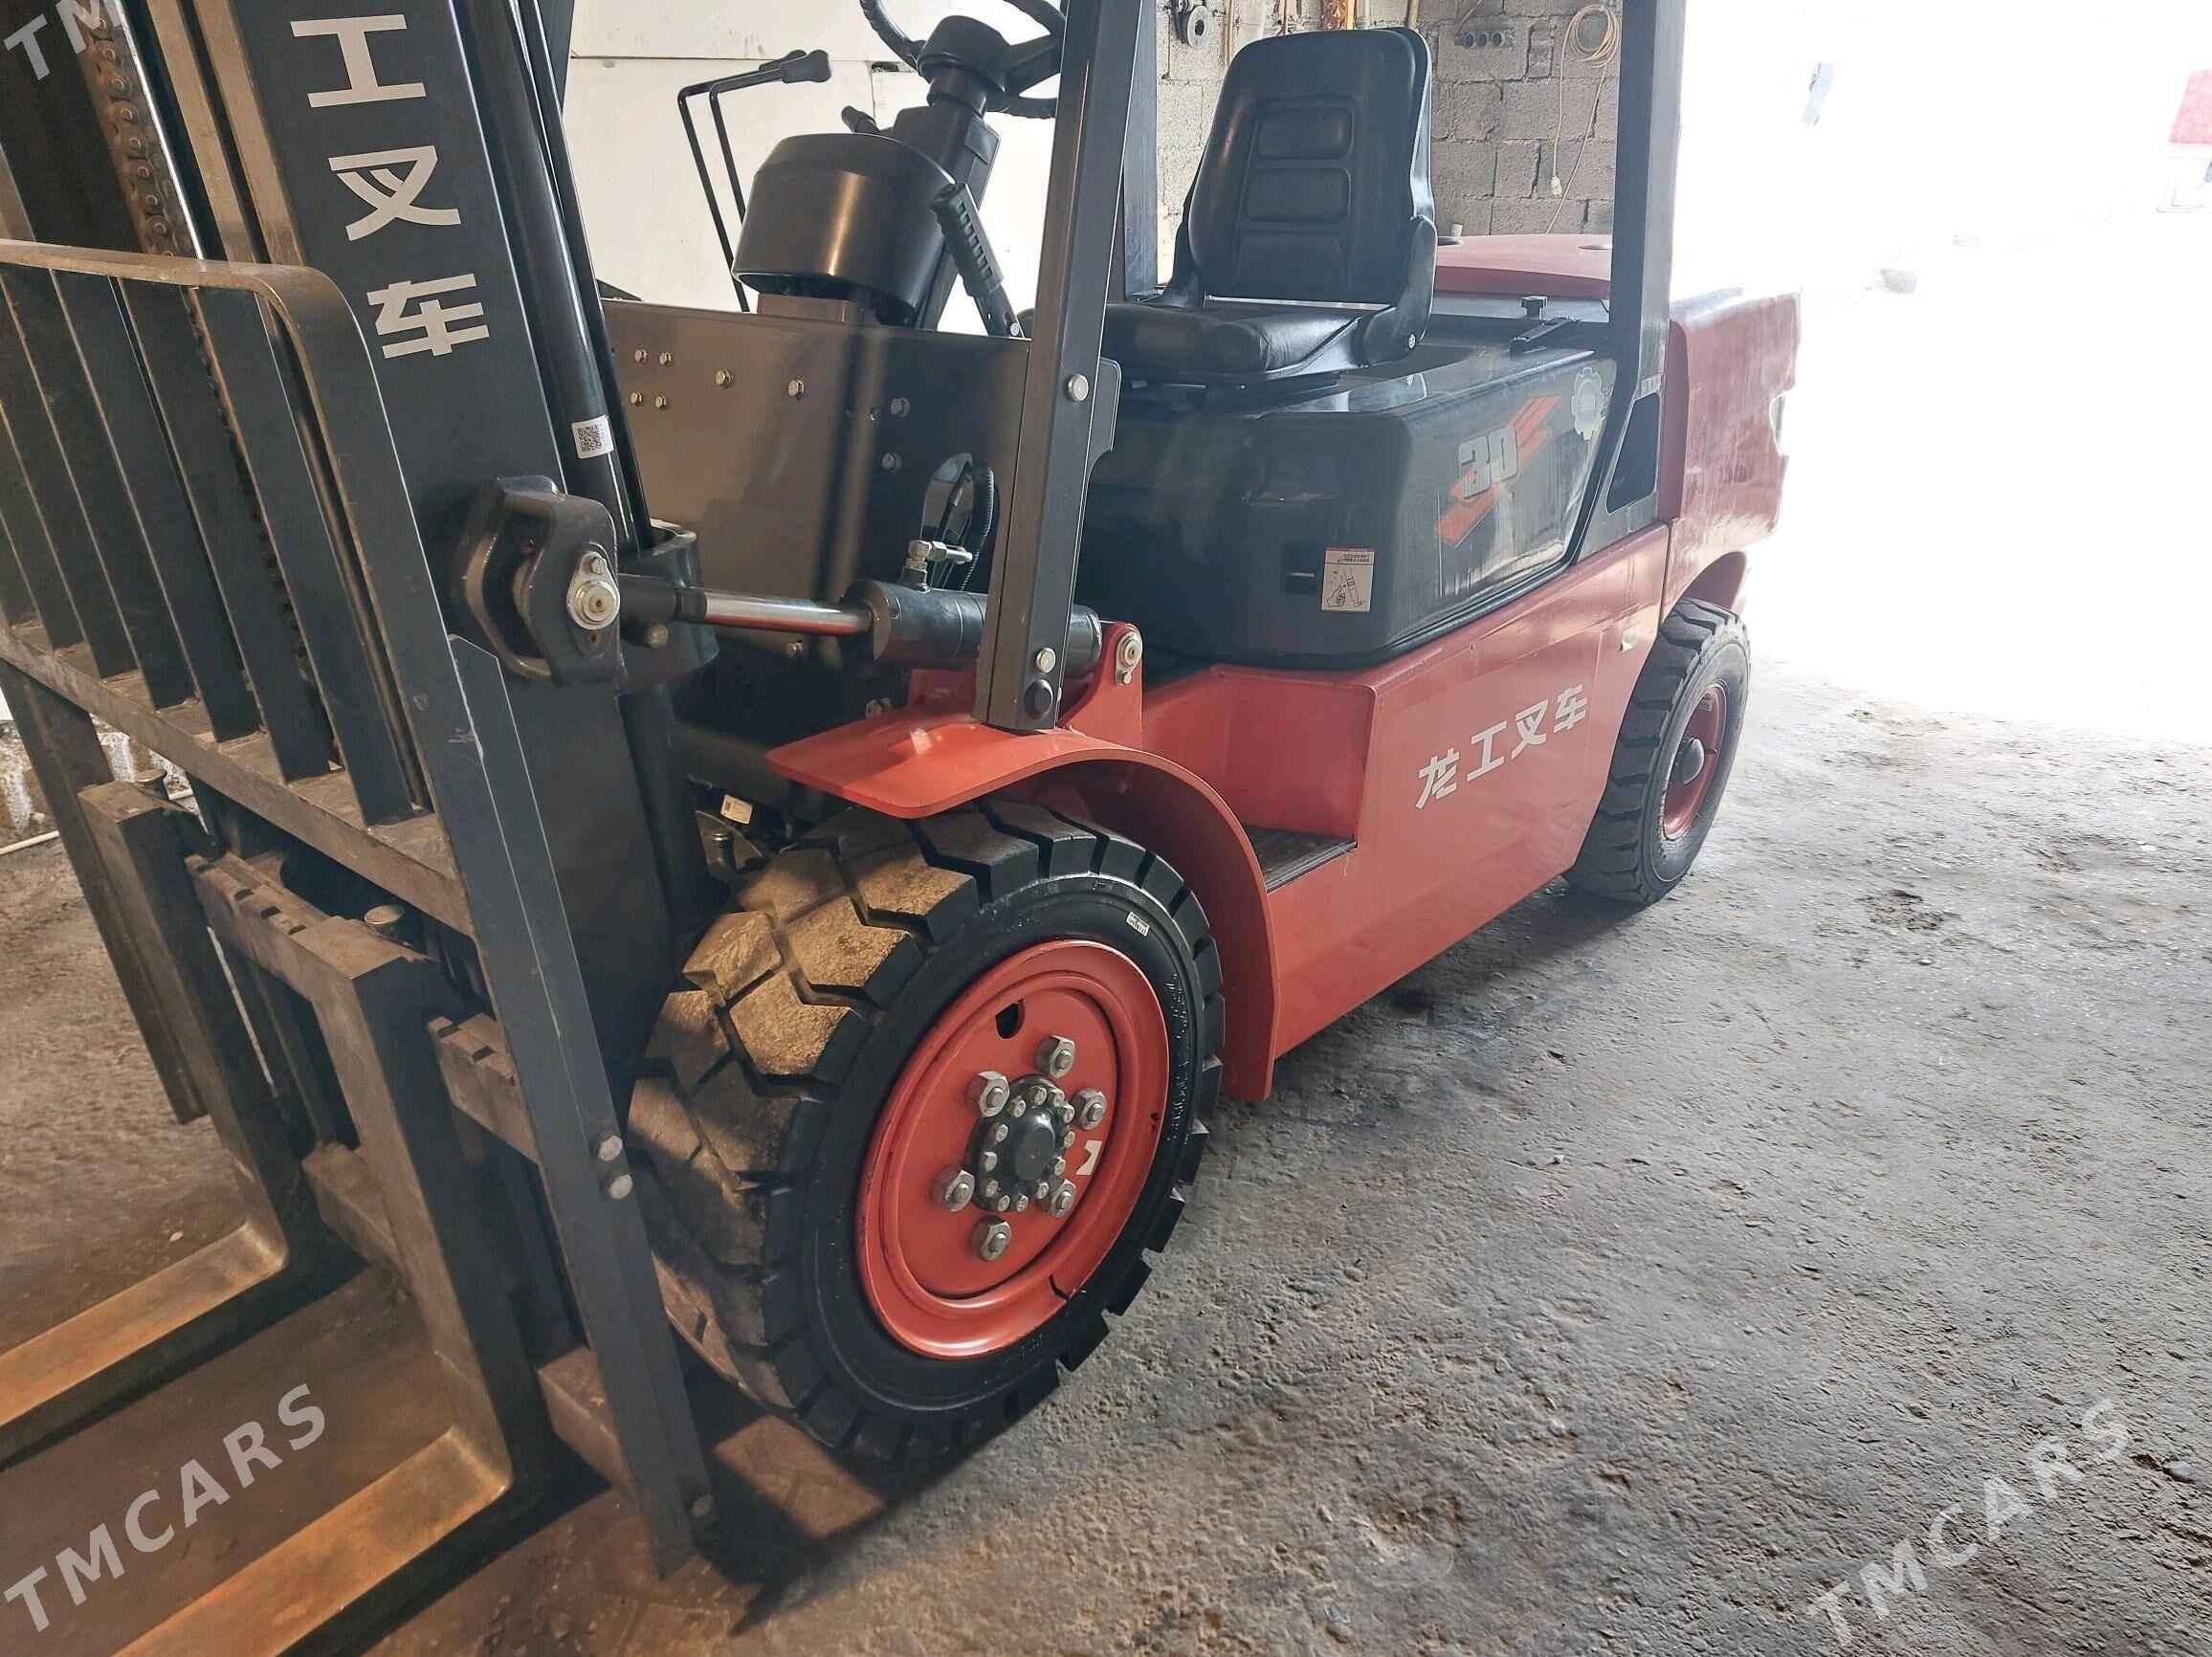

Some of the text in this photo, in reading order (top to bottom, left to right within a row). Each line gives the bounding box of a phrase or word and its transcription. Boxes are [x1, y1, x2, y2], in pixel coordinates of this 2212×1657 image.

[290, 13, 491, 361] 工叉车
[1456, 424, 1519, 499] 30
[1415, 683, 1588, 810] 龙工叉车
